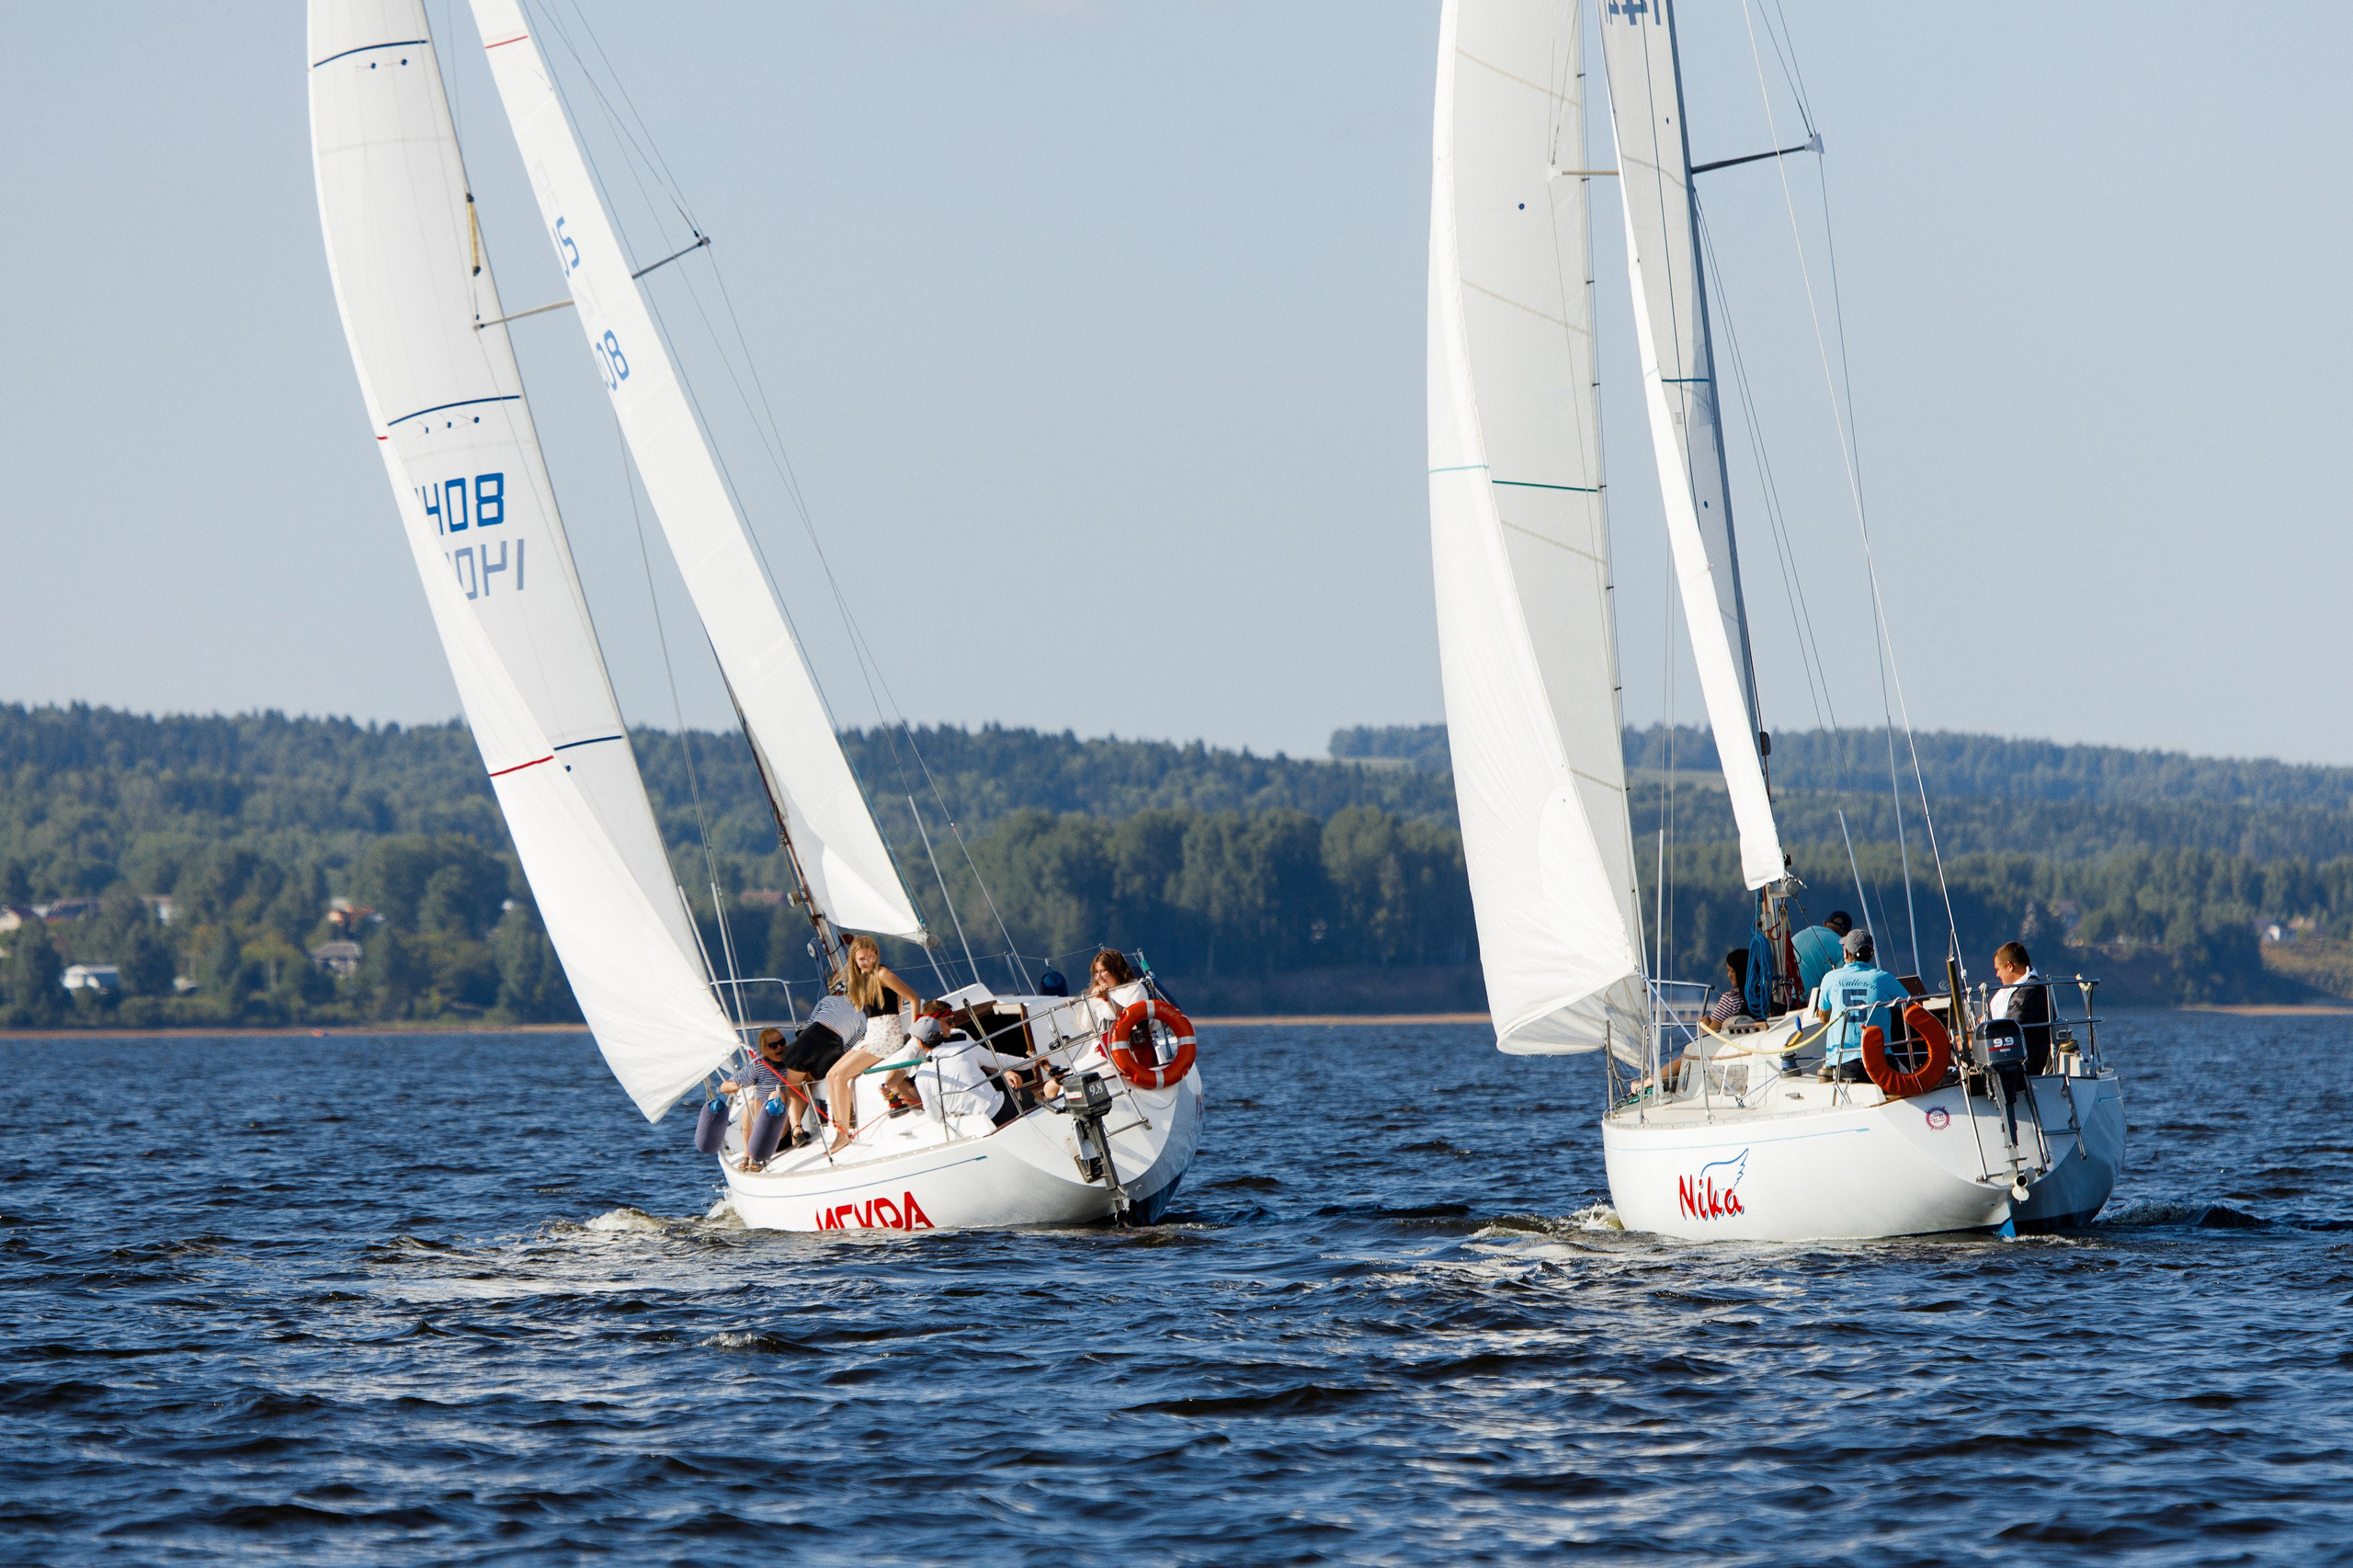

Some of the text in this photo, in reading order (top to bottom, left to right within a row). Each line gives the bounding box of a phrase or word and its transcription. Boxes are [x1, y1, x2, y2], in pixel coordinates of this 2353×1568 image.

[595, 329, 630, 392] 08
[415, 472, 505, 536] 408
[1842, 989, 1868, 1023] 5
[1993, 1036, 2015, 1048] 9.9
[1088, 1082, 1103, 1097] 9.8
[1679, 1174, 1745, 1221] Nika
